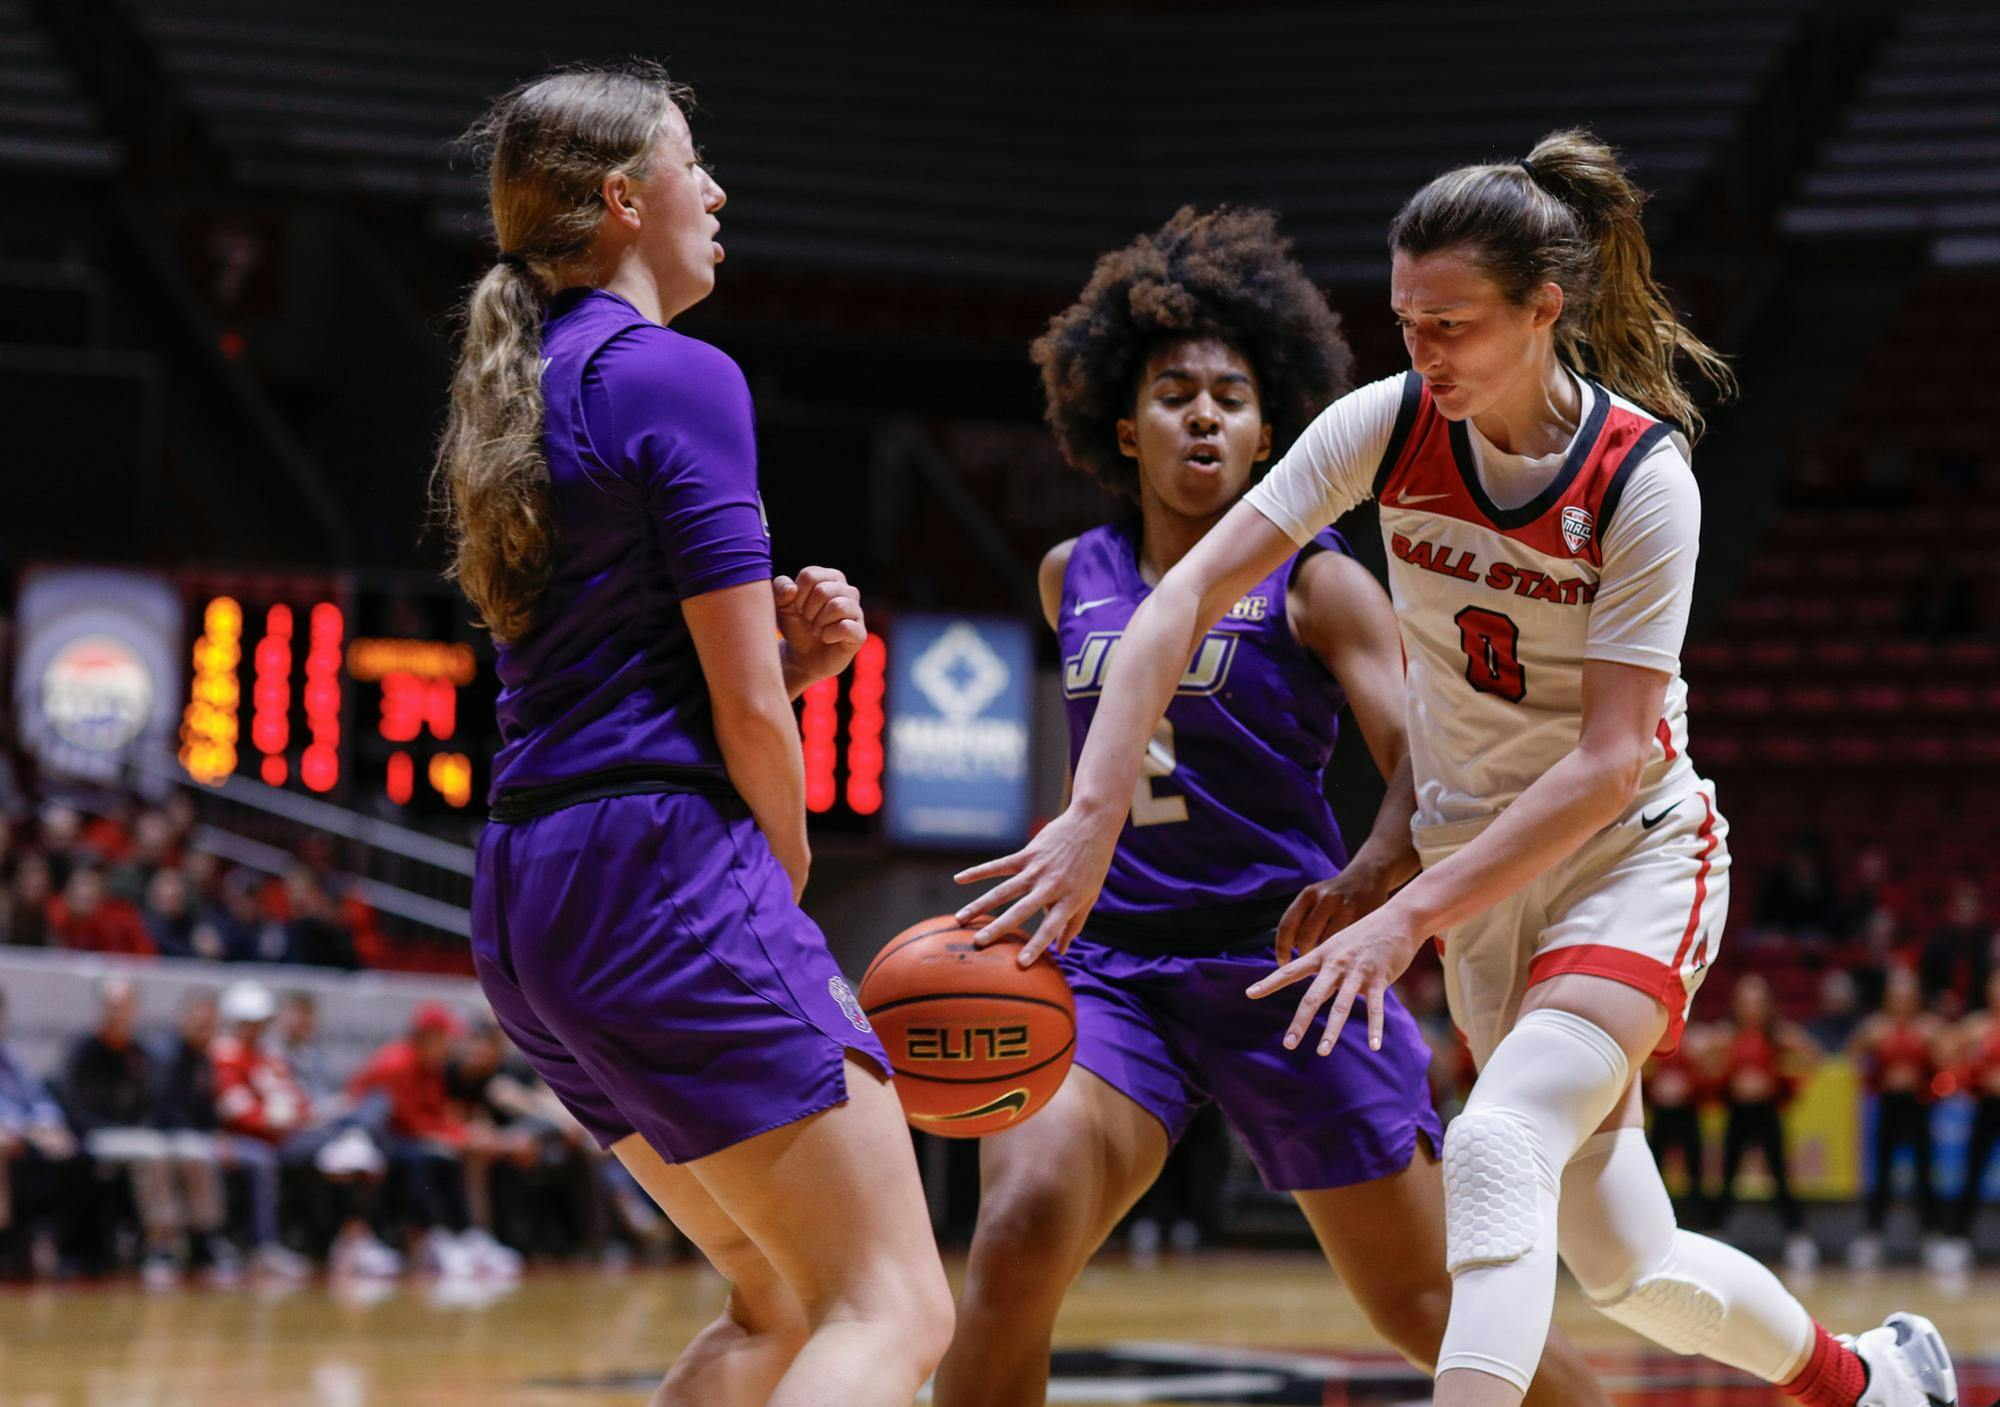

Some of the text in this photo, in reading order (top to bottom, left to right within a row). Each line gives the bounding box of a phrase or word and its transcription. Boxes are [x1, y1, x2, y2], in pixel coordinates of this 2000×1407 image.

[1564, 519, 1592, 538] MAC
[1391, 530, 1480, 583] BALL
[1454, 605, 1527, 704] 0
[906, 1024, 1030, 1062] ELITE
